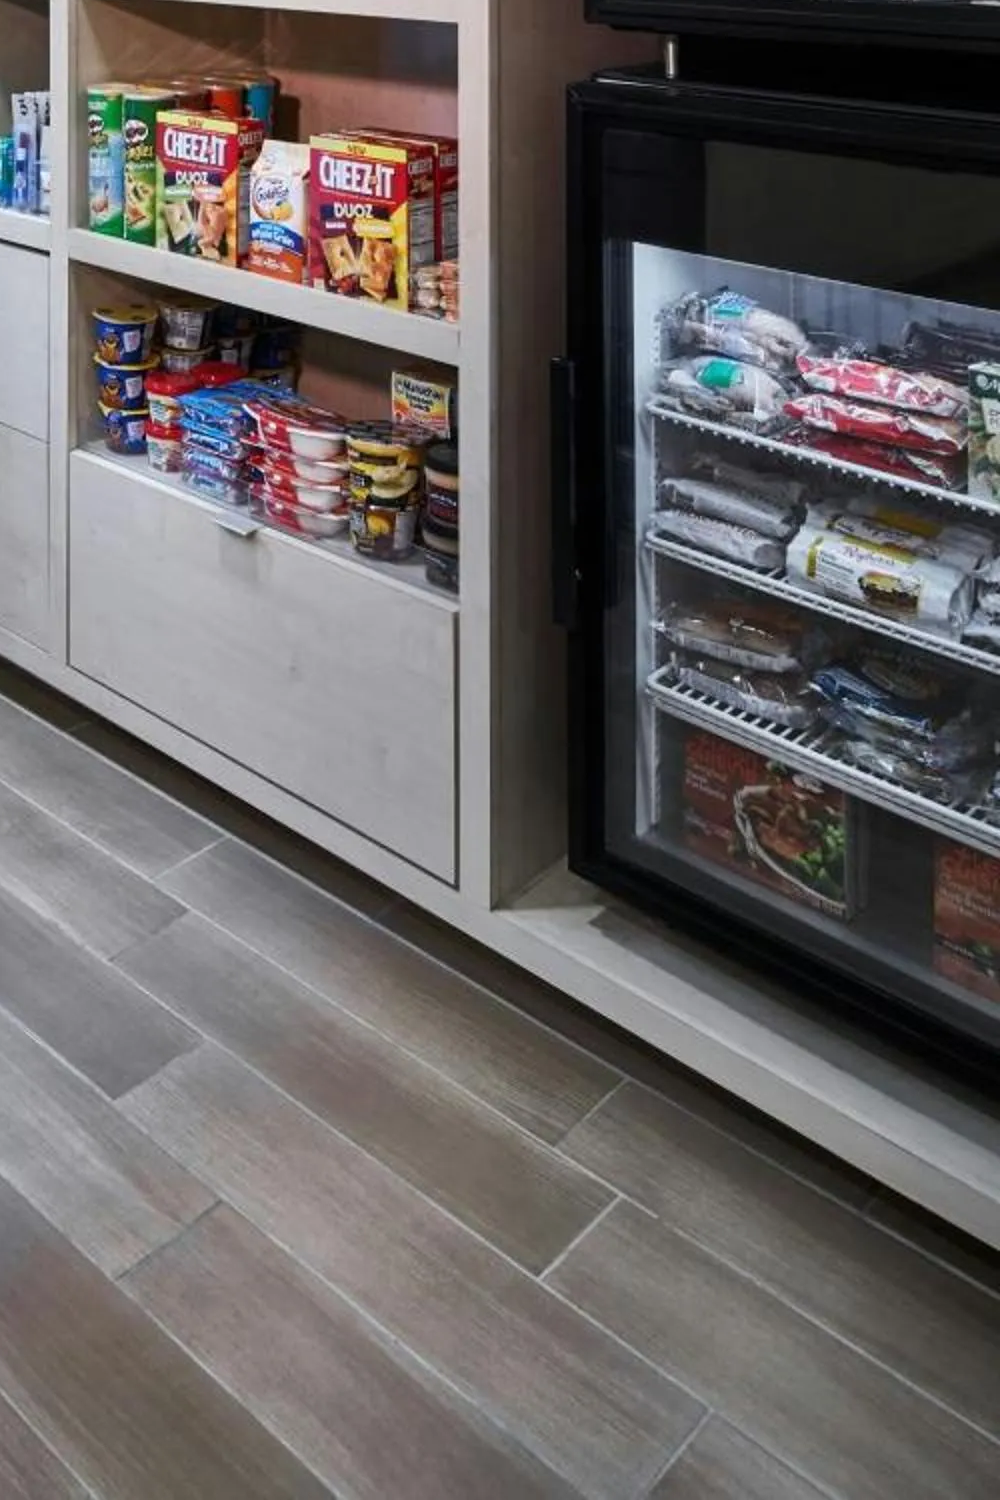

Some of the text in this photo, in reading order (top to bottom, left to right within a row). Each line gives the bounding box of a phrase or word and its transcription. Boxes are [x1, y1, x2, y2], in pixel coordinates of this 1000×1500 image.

[163, 128, 228, 167] CHEEZ-IT
[318, 155, 396, 199] CHEEZ-IT
[333, 202, 375, 219] DUOZ
